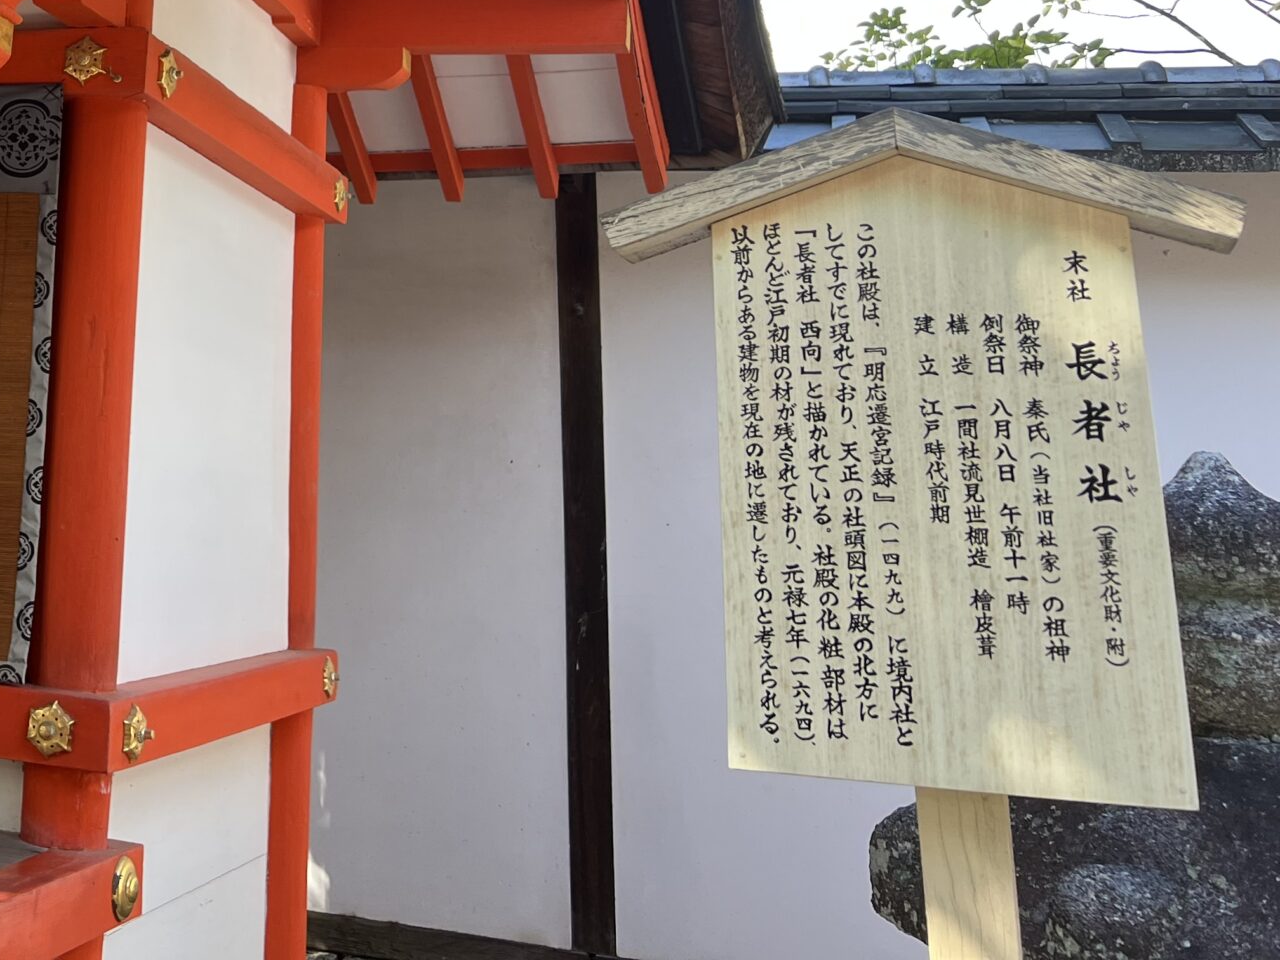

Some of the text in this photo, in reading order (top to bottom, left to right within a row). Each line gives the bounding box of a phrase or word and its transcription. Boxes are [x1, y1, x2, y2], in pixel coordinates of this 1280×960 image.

[1014, 312, 1045, 377] 御祭神
[919, 397, 951, 524] 江戸時代前期
[979, 312, 1030, 616] 例祭日 八月八日 午前十一時
[1063, 250, 1130, 667] 末社 長者社 （重要文化財・附）
[969, 588, 997, 660] 檜皮葺
